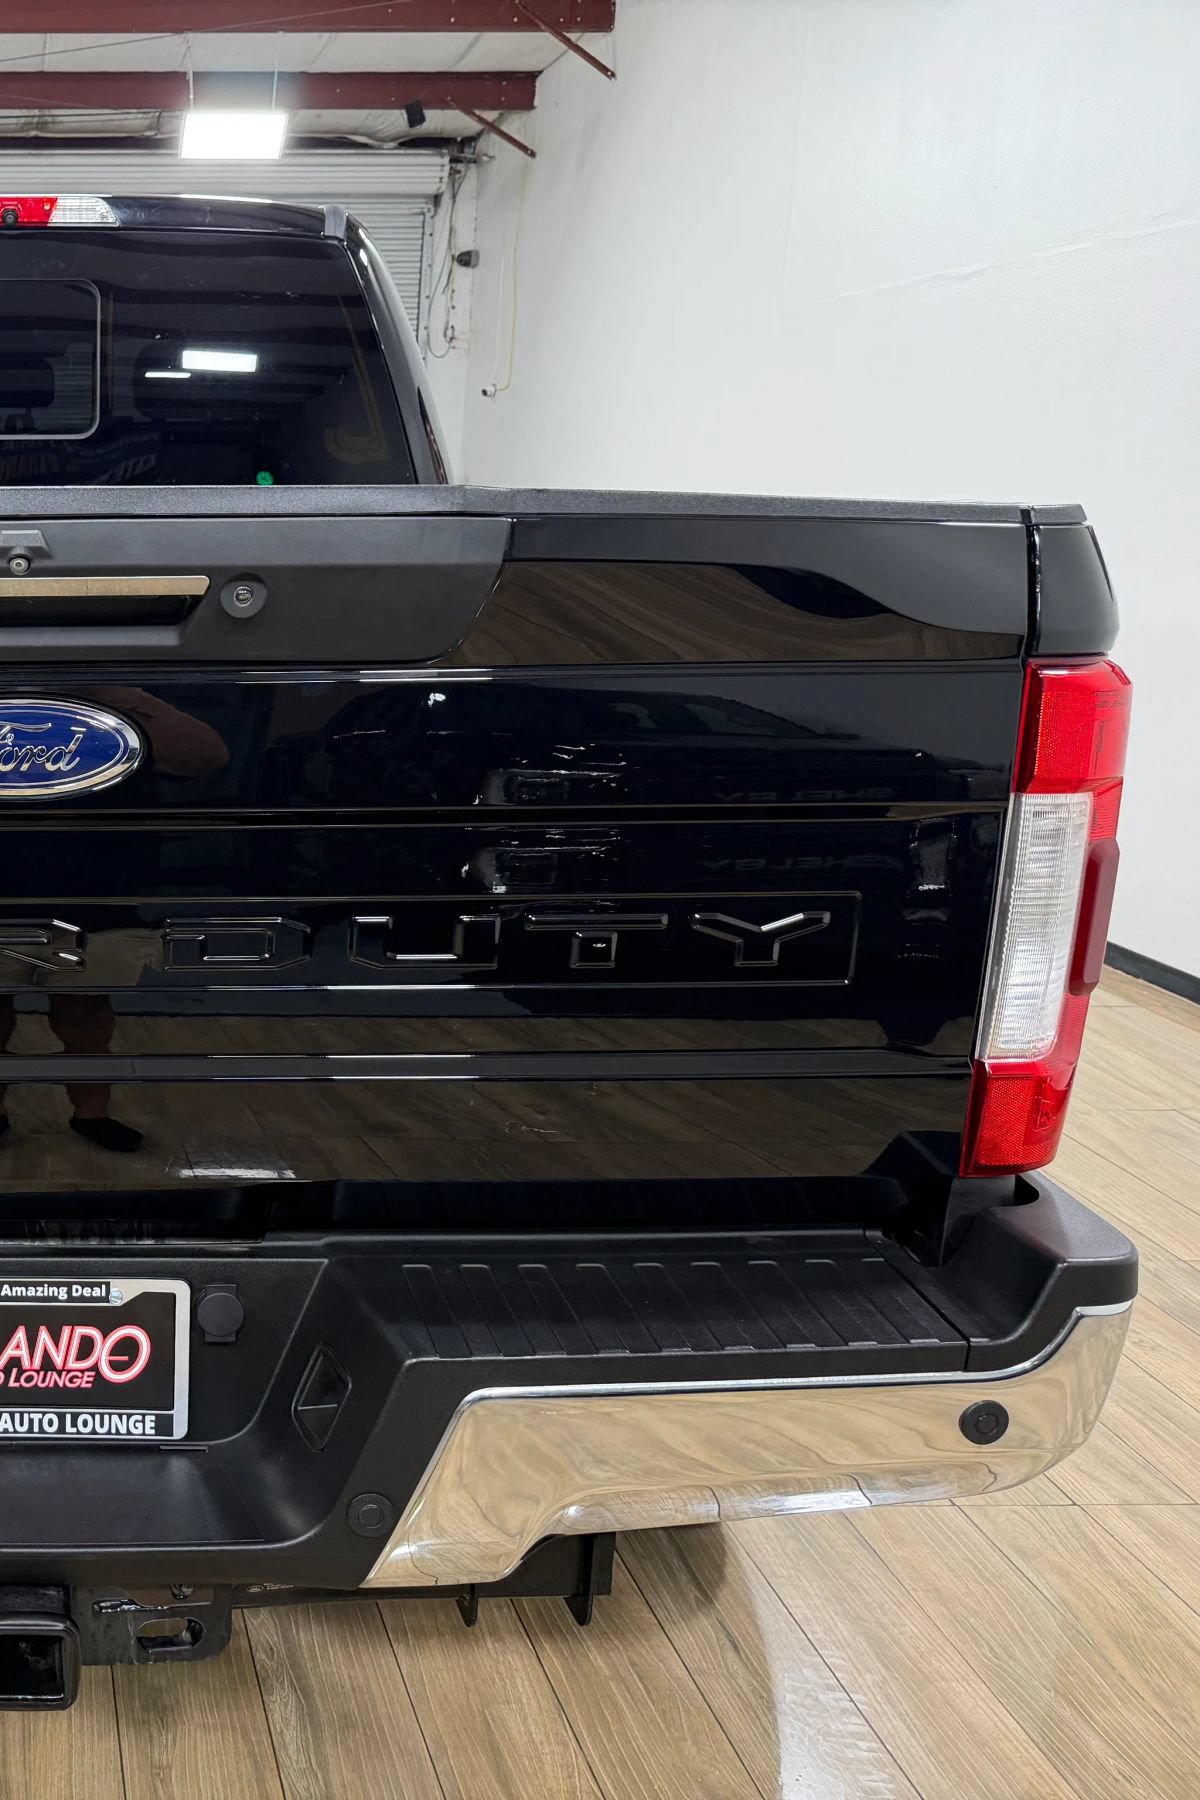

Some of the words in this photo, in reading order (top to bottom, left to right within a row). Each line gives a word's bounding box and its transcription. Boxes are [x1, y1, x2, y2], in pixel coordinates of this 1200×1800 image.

[163, 911, 832, 971] DUTY
[1, 1284, 68, 1300] Amazing
[71, 1284, 106, 1298] Deal
[8, 1369, 96, 1388] LOUNGE
[65, 1413, 156, 1435] LOUNGE
